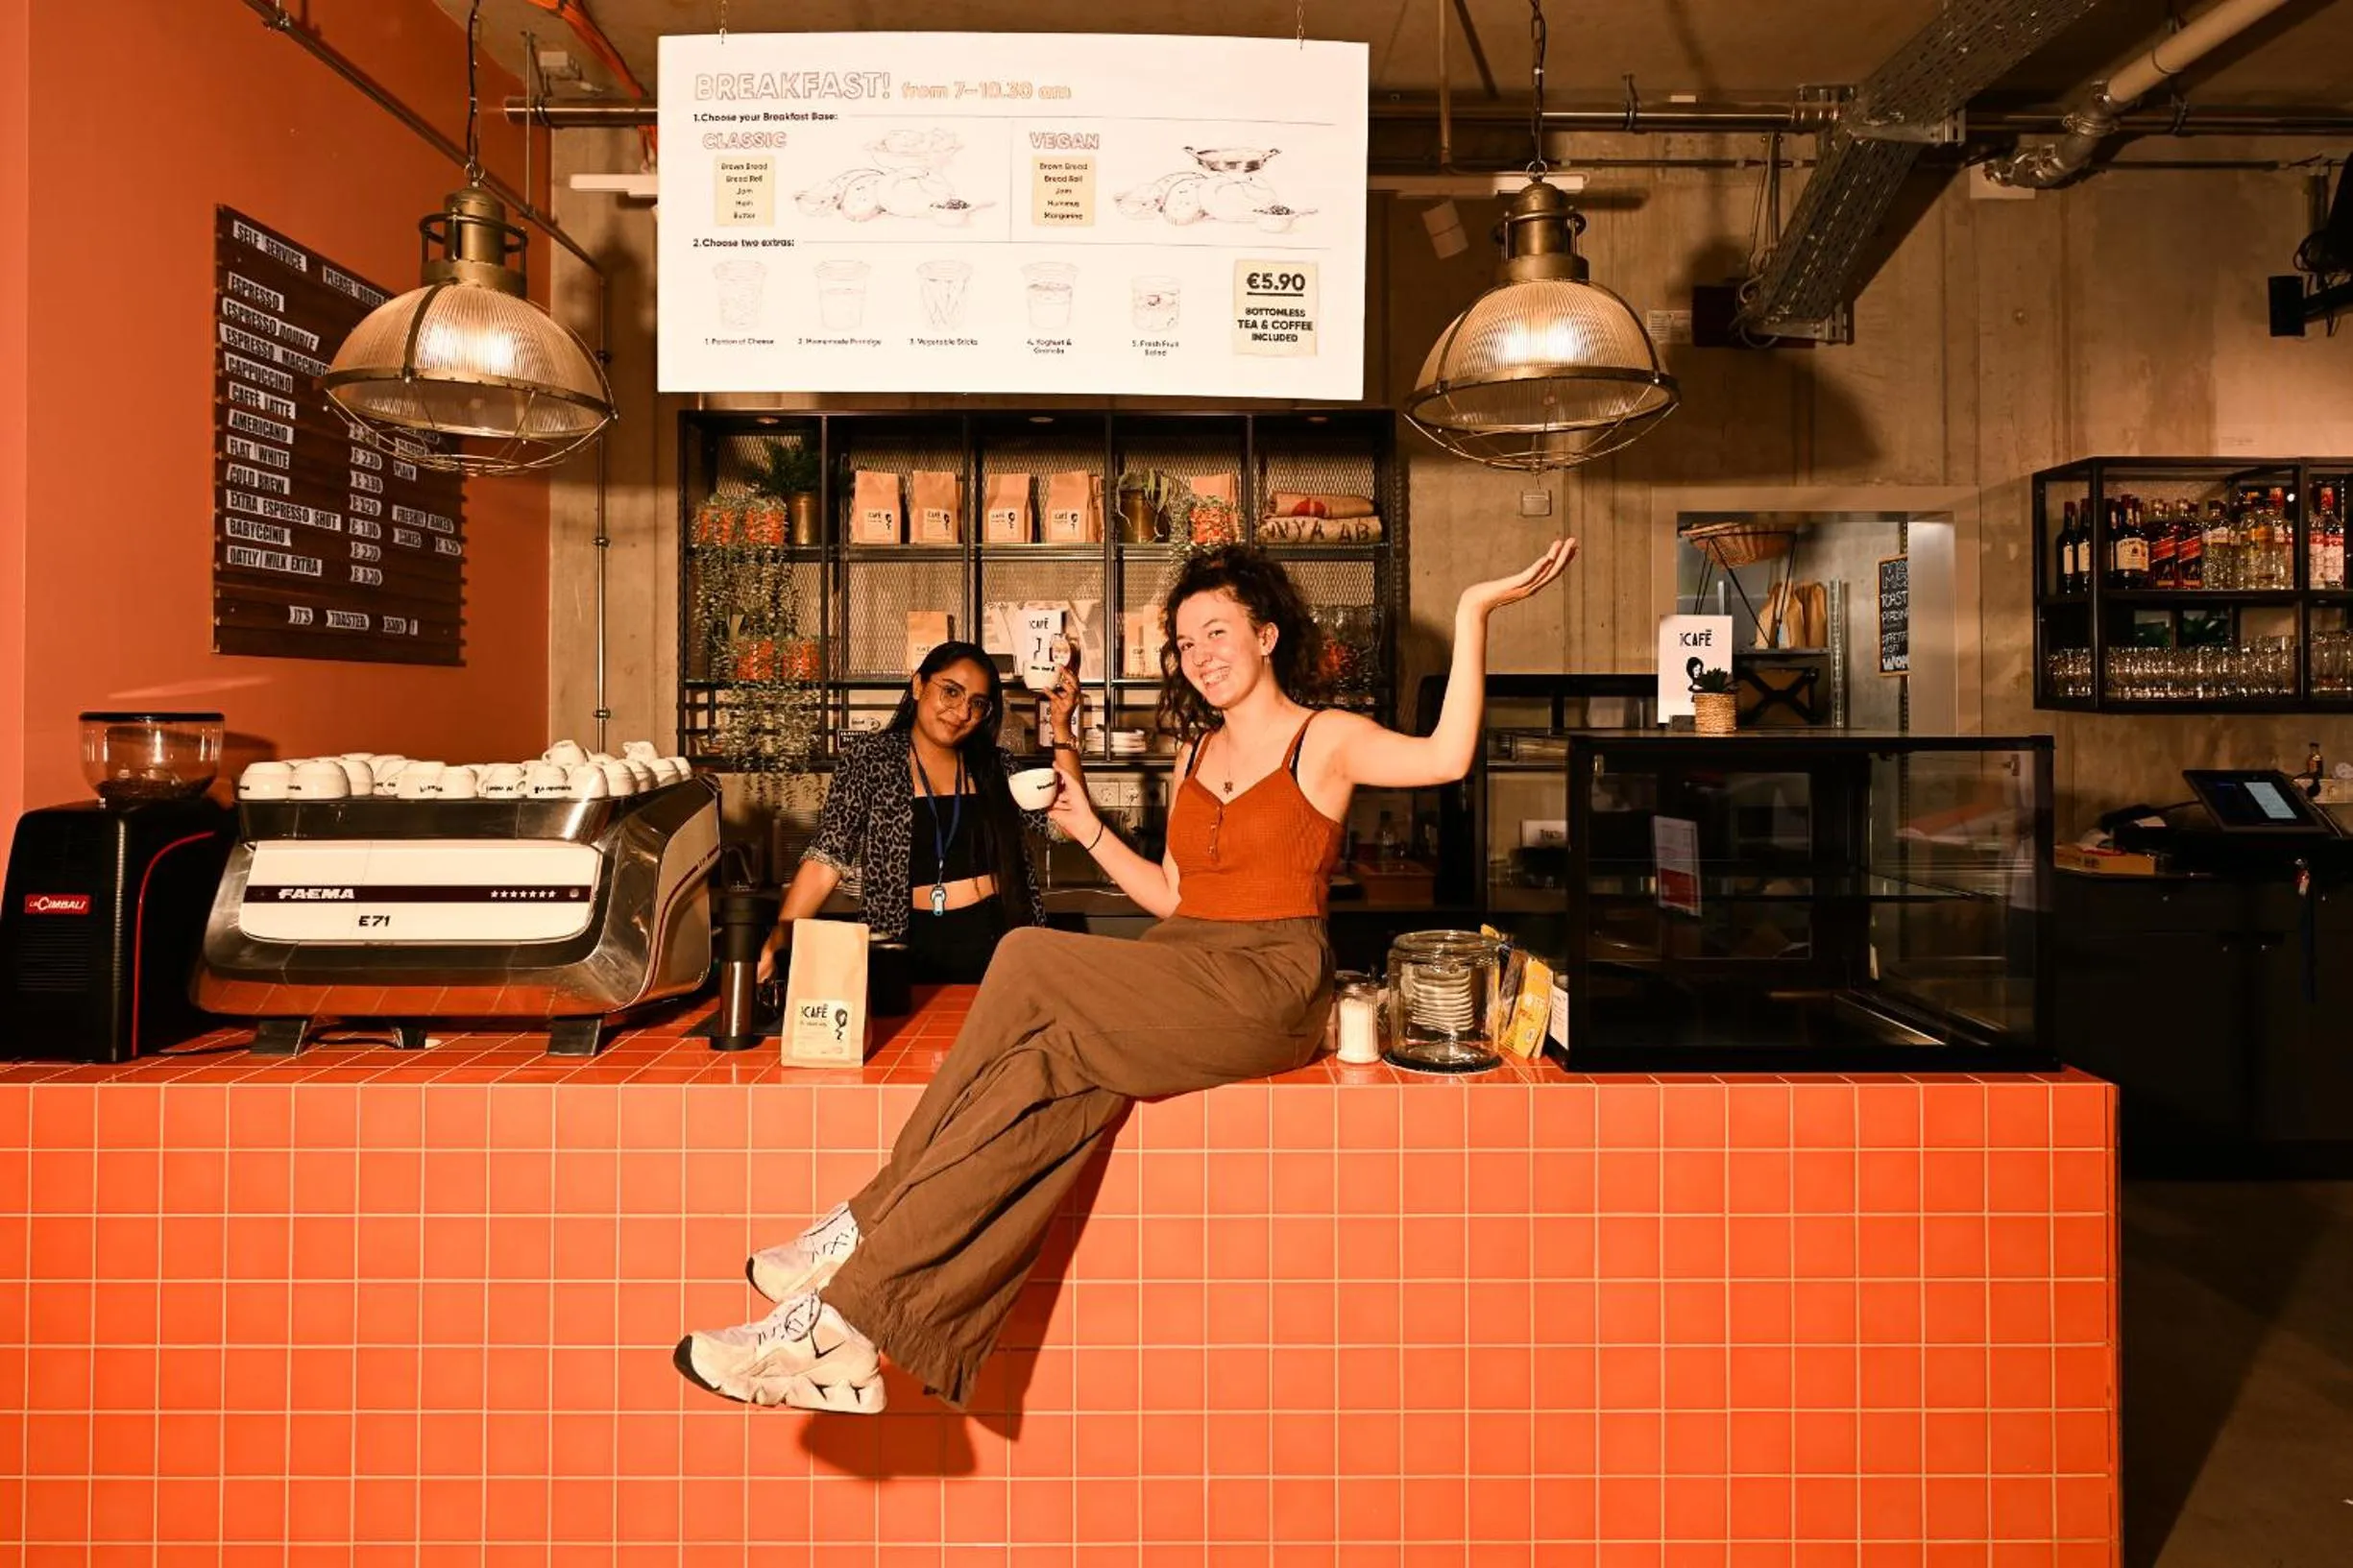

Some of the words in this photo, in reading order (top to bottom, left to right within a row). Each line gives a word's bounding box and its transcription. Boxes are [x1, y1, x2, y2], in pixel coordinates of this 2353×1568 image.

[695, 72, 890, 101] BREAKFAST!
[902, 82, 948, 99] from
[1038, 84, 1072, 100] am
[740, 114, 761, 123] your
[763, 112, 809, 121] Breakfast
[812, 112, 838, 121] Base:
[702, 132, 787, 150] CLASSIC
[1029, 132, 1100, 150] VEGAN
[741, 238, 759, 247] two
[761, 238, 795, 247] extras:
[231, 275, 280, 309] ESPRESSO
[1247, 273, 1306, 291] €5.90
[227, 300, 277, 336] ESPRESSO
[1246, 307, 1306, 317] BOTTOMLESS
[1237, 320, 1257, 329] TEA
[1261, 320, 1269, 329] &
[1272, 321, 1313, 331] COFFEE
[1251, 333, 1298, 343] INCLUDED
[226, 326, 275, 361] ESPRESSO
[229, 356, 292, 393] CAPPUCCINO
[264, 396, 293, 418] LATTE
[231, 412, 288, 442] AMERICANO
[230, 438, 252, 459] FLAT
[258, 446, 289, 470] WHITE
[230, 466, 255, 486] COLD
[257, 471, 285, 494] BREW
[230, 491, 258, 512] EXTRA
[262, 498, 310, 523] ESPRESSO
[314, 510, 339, 529] SHOT
[230, 519, 285, 544] BABYCCINO
[230, 546, 260, 567] OATLY
[264, 552, 287, 569] MILK
[290, 556, 319, 574] EXTRA
[279, 888, 355, 900] FAEMA
